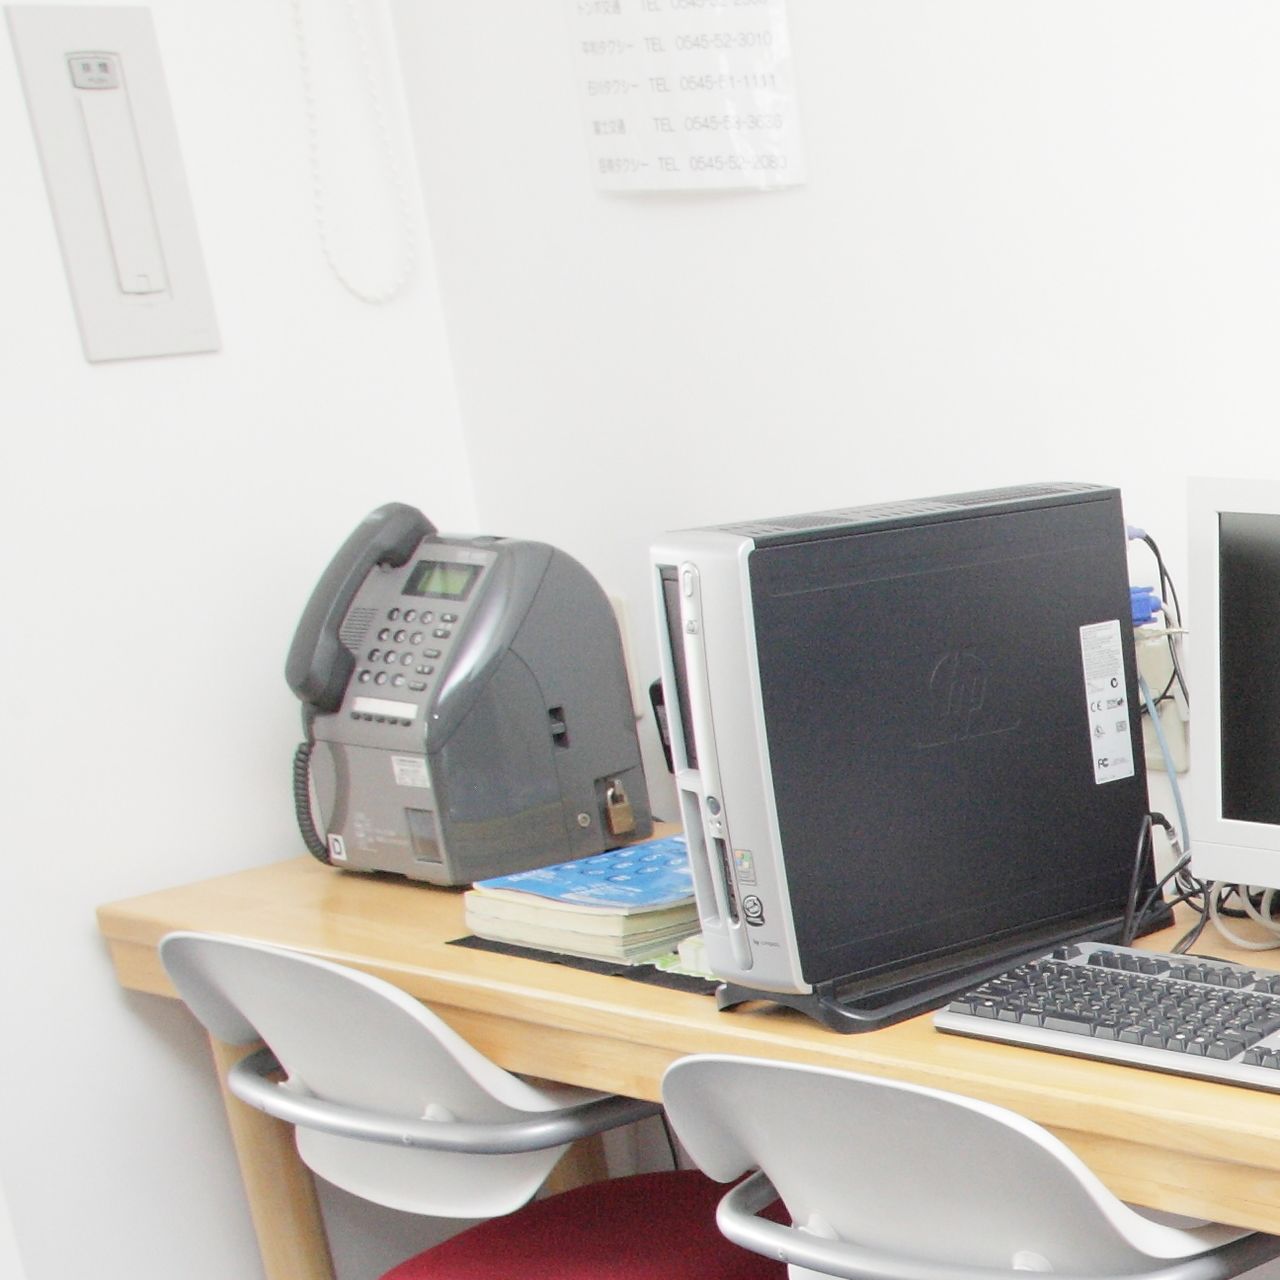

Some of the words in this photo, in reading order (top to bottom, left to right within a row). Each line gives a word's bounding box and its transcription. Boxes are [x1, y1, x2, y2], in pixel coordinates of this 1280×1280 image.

[644, 36, 666, 52] TEL
[674, 30, 772, 51] 0545-52-3010
[649, 76, 671, 92] TEL
[653, 116, 675, 133] TEL
[657, 155, 680, 171] TEL
[333, 838, 342, 855] D
